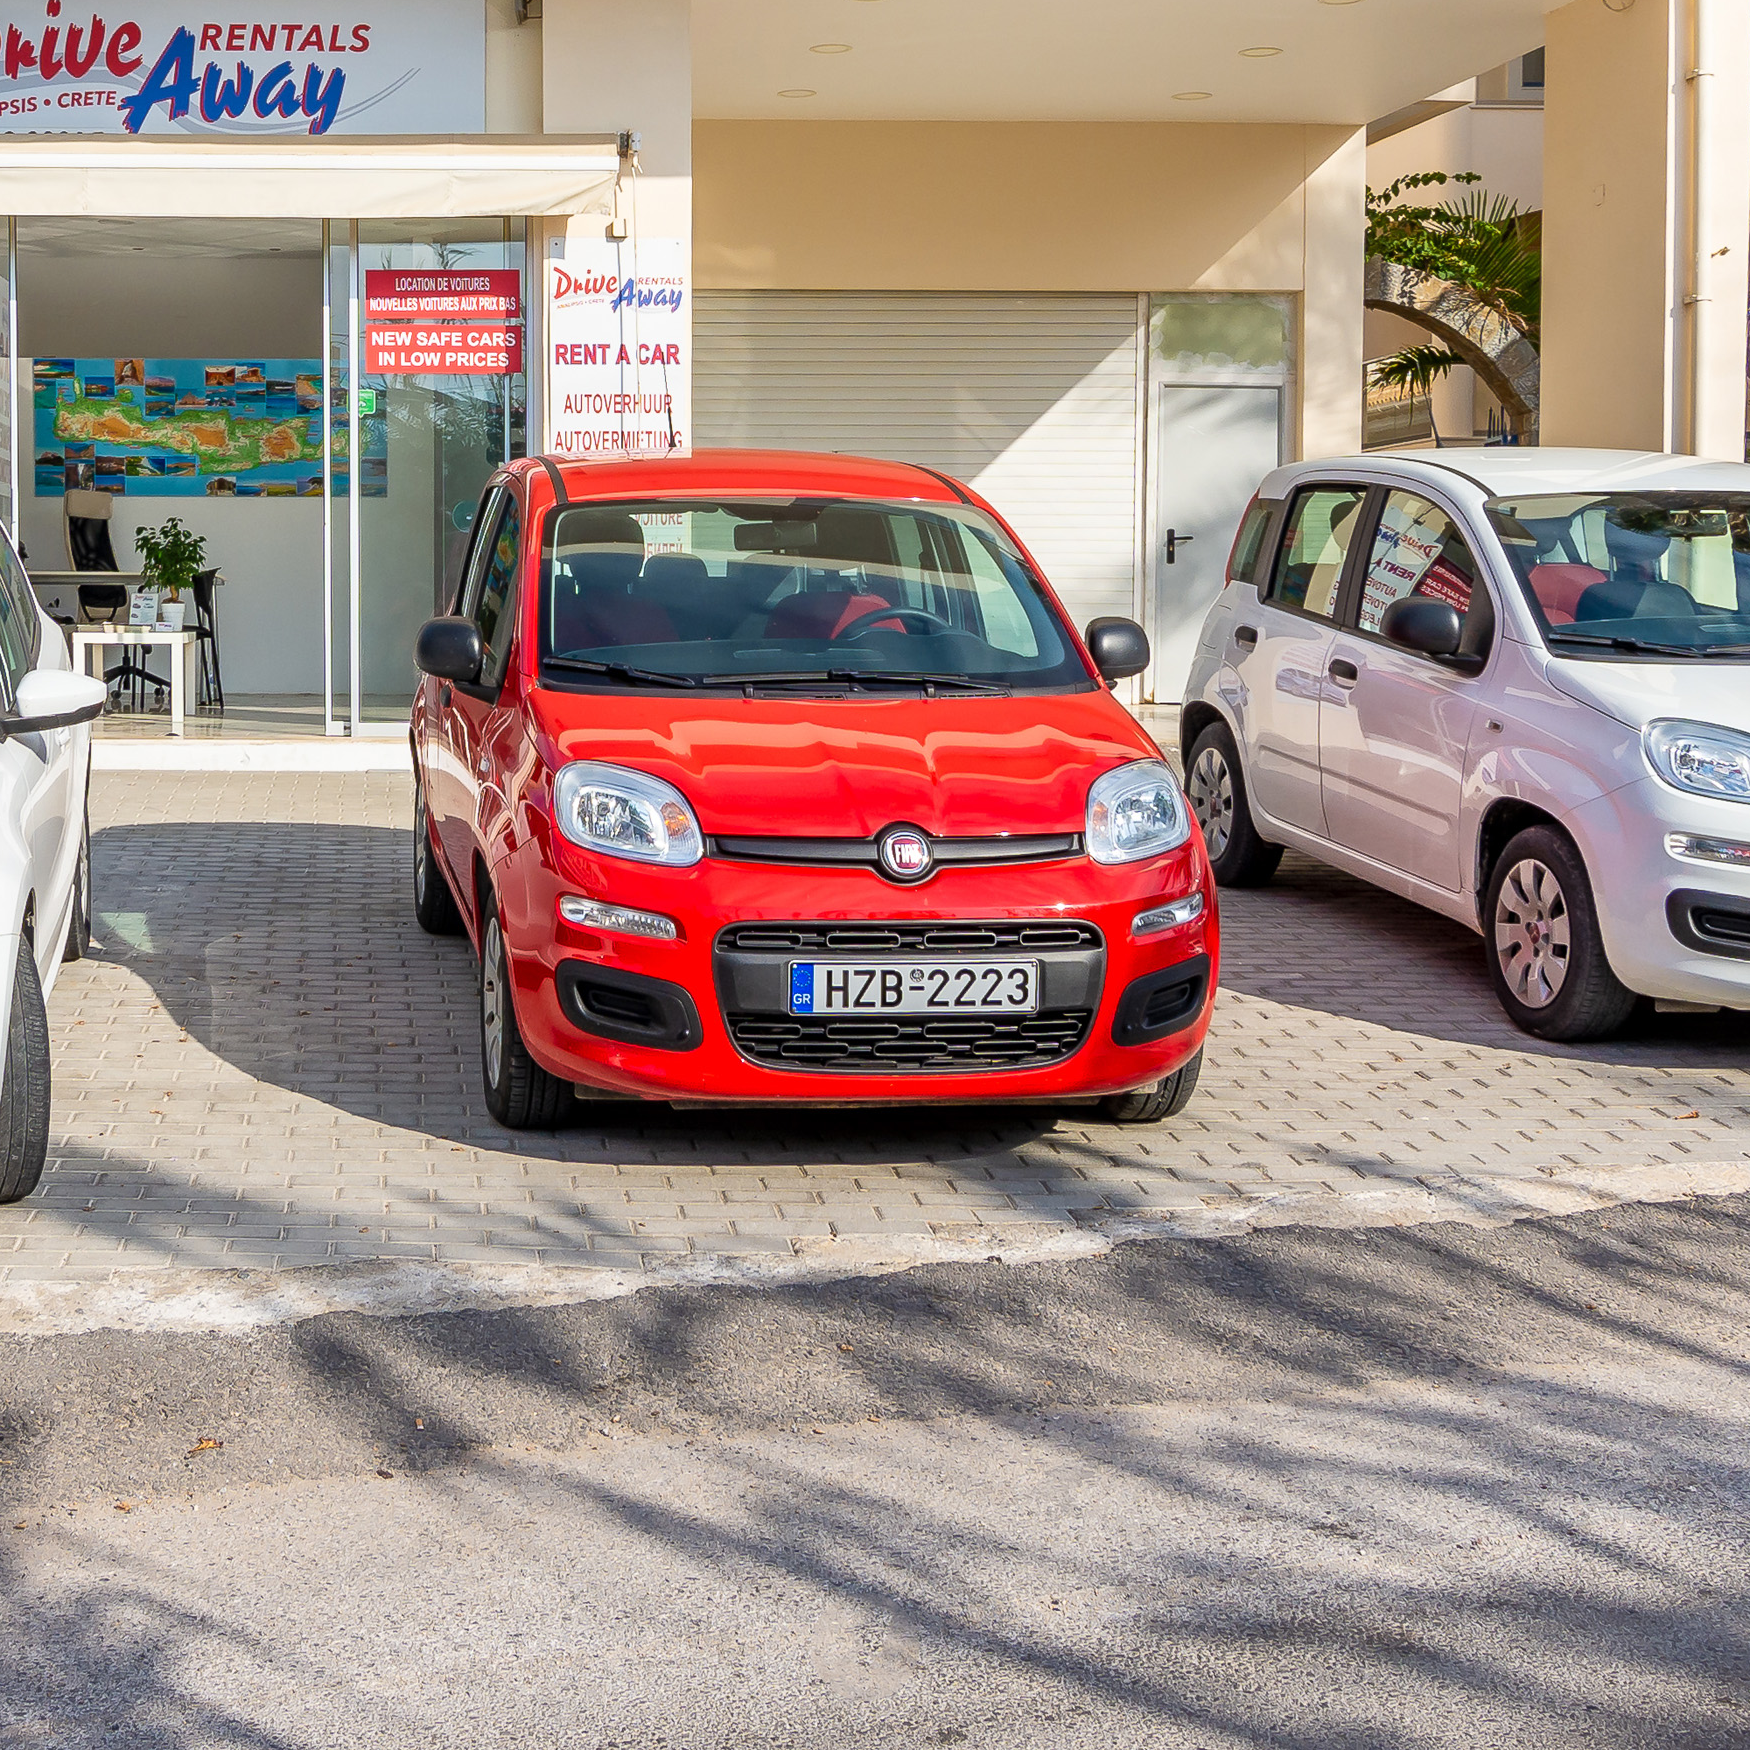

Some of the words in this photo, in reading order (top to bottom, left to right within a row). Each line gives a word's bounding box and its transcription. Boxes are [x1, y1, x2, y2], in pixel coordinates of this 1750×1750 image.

[199, 23, 372, 52] RENTALS
[117, 25, 347, 135] Away
[57, 90, 117, 109] CRETE
[395, 277, 436, 291] LOCATION
[437, 277, 449, 291] DE
[450, 277, 490, 291] VOITURES
[553, 266, 618, 300] Drive
[637, 277, 684, 286] RENTALS
[370, 297, 418, 311] NOUVELLES
[419, 297, 460, 311] VOITURES
[461, 297, 478, 311] AUX
[479, 297, 498, 311] PRIX
[499, 297, 516, 311] BAS
[610, 277, 683, 313] Away
[371, 332, 412, 346] NEW
[416, 332, 463, 346] SAFE
[467, 333, 516, 347] CARS
[378, 352, 395, 366] IN
[400, 352, 441, 367] LOW
[445, 352, 509, 367] PRICES
[555, 344, 610, 365] RENT
[615, 344, 631, 365] A
[639, 344, 681, 365] CAR
[563, 394, 673, 414] AUTOVERHUUR
[793, 993, 811, 1005] GR
[825, 967, 1030, 1009] HZB-2223
